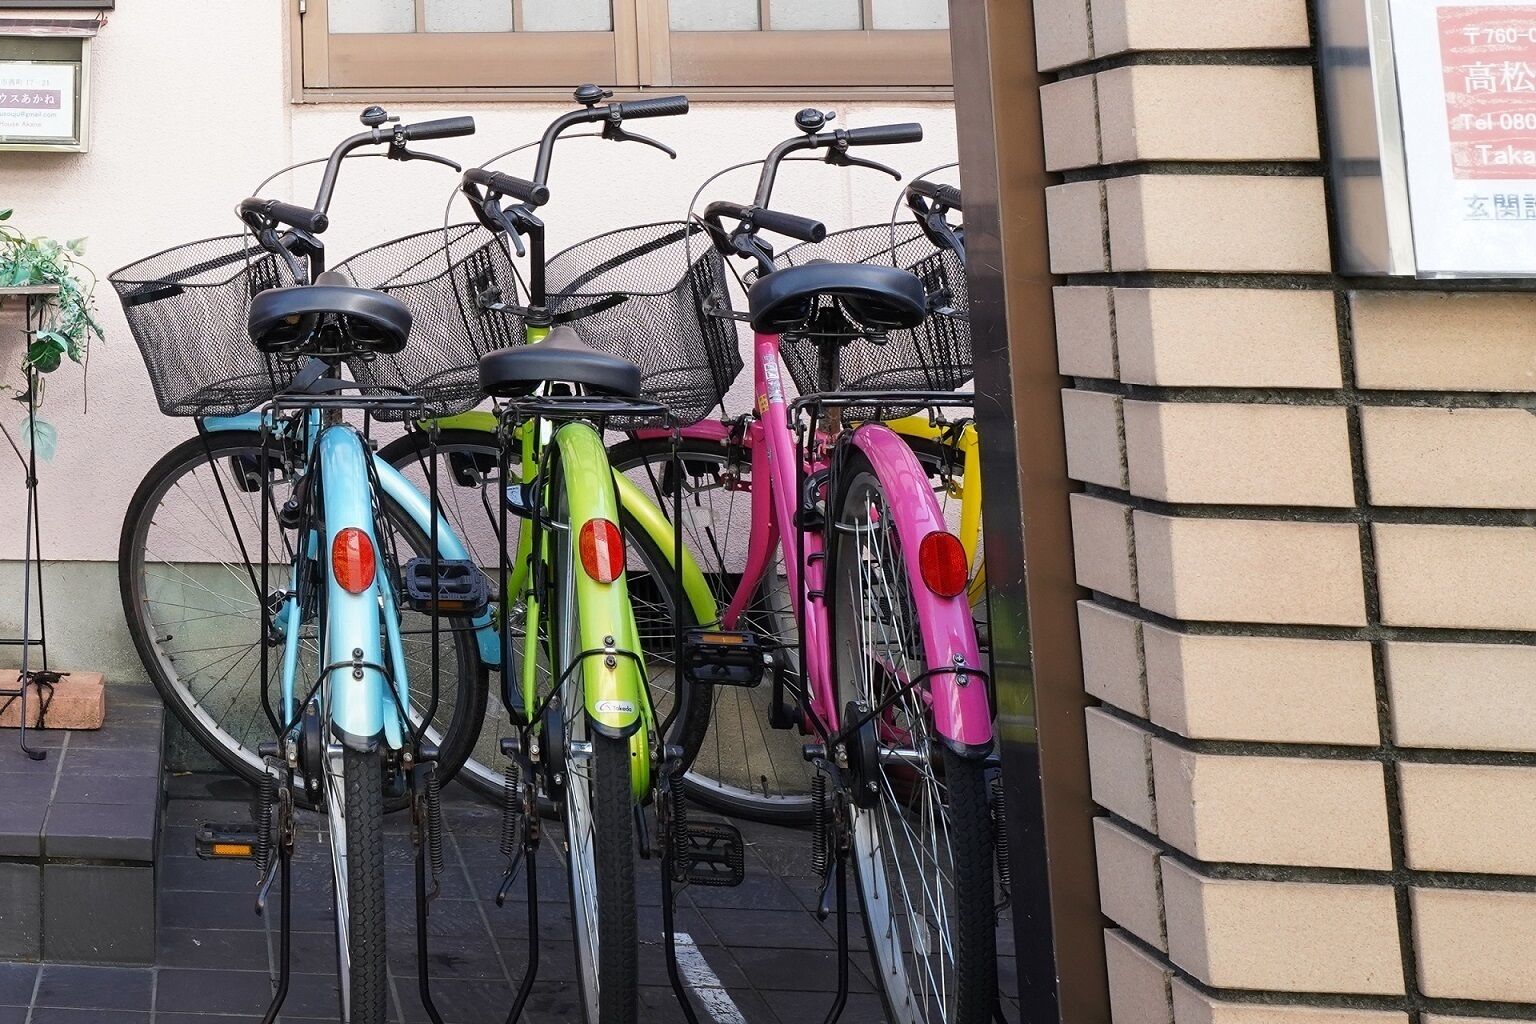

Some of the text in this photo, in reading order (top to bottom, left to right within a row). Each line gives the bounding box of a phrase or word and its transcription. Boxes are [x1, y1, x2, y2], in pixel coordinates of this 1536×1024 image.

[1463, 61, 1536, 94] 高松
[1460, 112, 1536, 130] Tel 080
[1475, 144, 1536, 165] Taka
